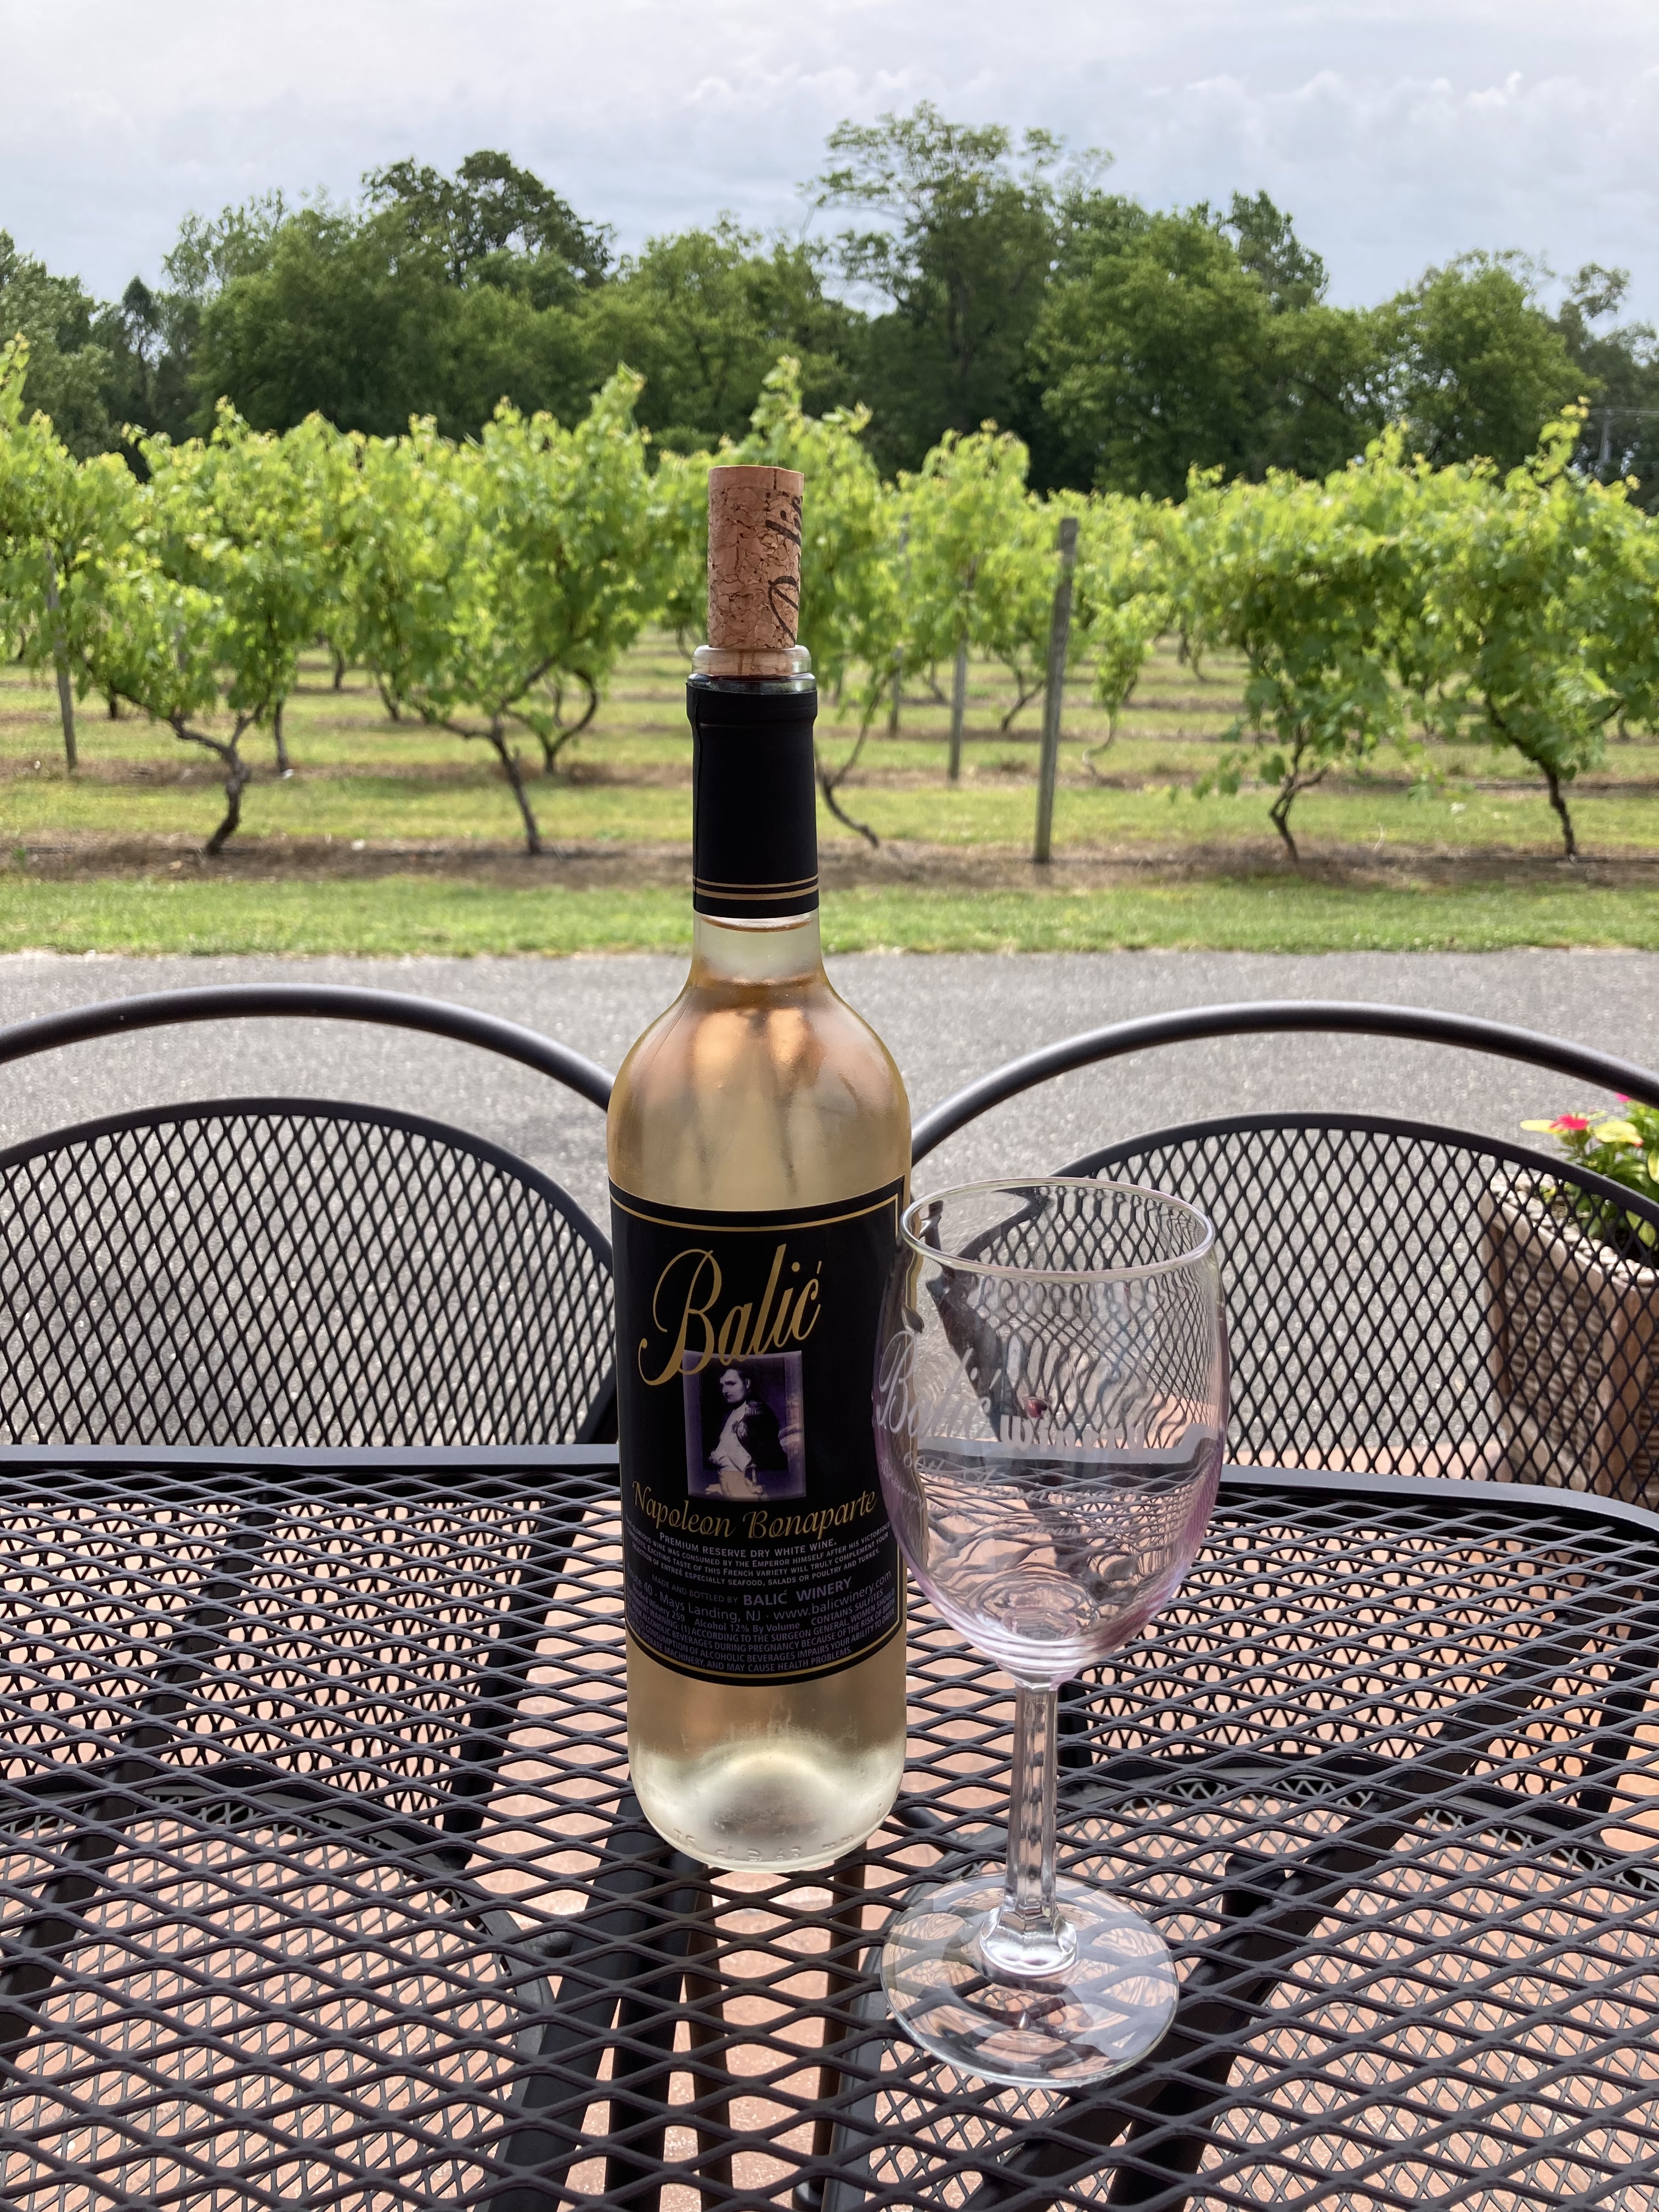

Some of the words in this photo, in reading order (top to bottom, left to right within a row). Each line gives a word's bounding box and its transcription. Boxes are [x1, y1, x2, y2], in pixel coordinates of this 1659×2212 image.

[637, 1243, 822, 1386] Balić
[633, 1481, 736, 1537] Napoleon
[742, 1490, 877, 1540] Bonaparte
[653, 1539, 665, 1551] WINE
[668, 1547, 680, 1556] WAS
[682, 1553, 720, 1565] CONSUMED
[752, 1559, 789, 1567] EMPEROR
[793, 1553, 823, 1564] HIMSELF
[826, 1546, 847, 1557] AFTER
[849, 1540, 859, 1549] HIS
[861, 1521, 891, 1544] VICTORIOUS
[660, 1532, 698, 1553] PREMIUM
[703, 1546, 746, 1558] RESERVE
[751, 1549, 770, 1558] DRY
[775, 1545, 805, 1556] WHITE
[809, 1538, 837, 1551] WINE.
[673, 1558, 691, 1570] TASTE
[705, 1566, 720, 1575] THIS
[756, 1568, 787, 1577] VARIETY
[791, 1565, 808, 1574] WILL
[811, 1559, 832, 1570] TRULY
[835, 1542, 875, 1564] COMPLEMENT
[876, 1532, 888, 1546] YOUR
[652, 1574, 670, 1589] MADE
[672, 1584, 686, 1594] AND
[689, 1590, 724, 1602] BOTTLED
[743, 1589, 787, 1605] BALIĆ
[796, 1576, 851, 1601] WINERY
[653, 1558, 659, 1566] OF
[685, 1571, 725, 1584] ESPECIALLY
[768, 1576, 796, 1585] SALADS
[812, 1566, 841, 1579] POULTRY
[844, 1559, 856, 1569] AND
[644, 1582, 652, 1595] 40
[660, 1591, 685, 1611] Mays
[689, 1602, 741, 1623] Landing,
[746, 1610, 760, 1621] NJ
[774, 1570, 891, 1620] www.balicwinery.com
[648, 1599, 670, 1618] Winery
[672, 1611, 685, 1622] 259
[695, 1618, 726, 1631] Alcohol
[730, 1624, 749, 1632] 12%
[753, 1625, 763, 1634] By
[766, 1622, 800, 1632] Volume
[811, 1606, 853, 1626] CONTAINS
[855, 1588, 883, 1611] SULFITES
[642, 1612, 671, 1637] ALCOHOLIC
[673, 1632, 713, 1649] BEVERAGES
[714, 1642, 746, 1652] DURING
[748, 1641, 799, 1652] PREGNANCY
[802, 1632, 836, 1648] BECAUSE
[838, 1628, 848, 1638] OF
[848, 1624, 860, 1634] THE
[861, 1616, 873, 1628] RISK
[875, 1609, 882, 1619] OF
[883, 1596, 895, 1613] BIRTH
[646, 1624, 690, 1651] CONSUMPTION
[690, 1646, 699, 1655] OF
[700, 1649, 744, 1662] ALCOHOLIC
[747, 1652, 795, 1662] BEVERAGES
[798, 1644, 829, 1658] IMPAIRS
[831, 1636, 850, 1651] YOUR
[851, 1624, 874, 1643] ABILITY
[874, 1620, 881, 1629] TO
[649, 1607, 680, 1630] WARNING:
[681, 1625, 690, 1635] (1)
[692, 1628, 738, 1642] ACCORDING
[753, 1634, 768, 1642] THE
[771, 1628, 811, 1641] SURGEON
[850, 1605, 875, 1623] WOMEN
[664, 1645, 706, 1668] MACHINERY,
[748, 1663, 775, 1672] CAUSE
[778, 1660, 808, 1671] HEALTH
[811, 1647, 851, 1666] PROBLEMS.
